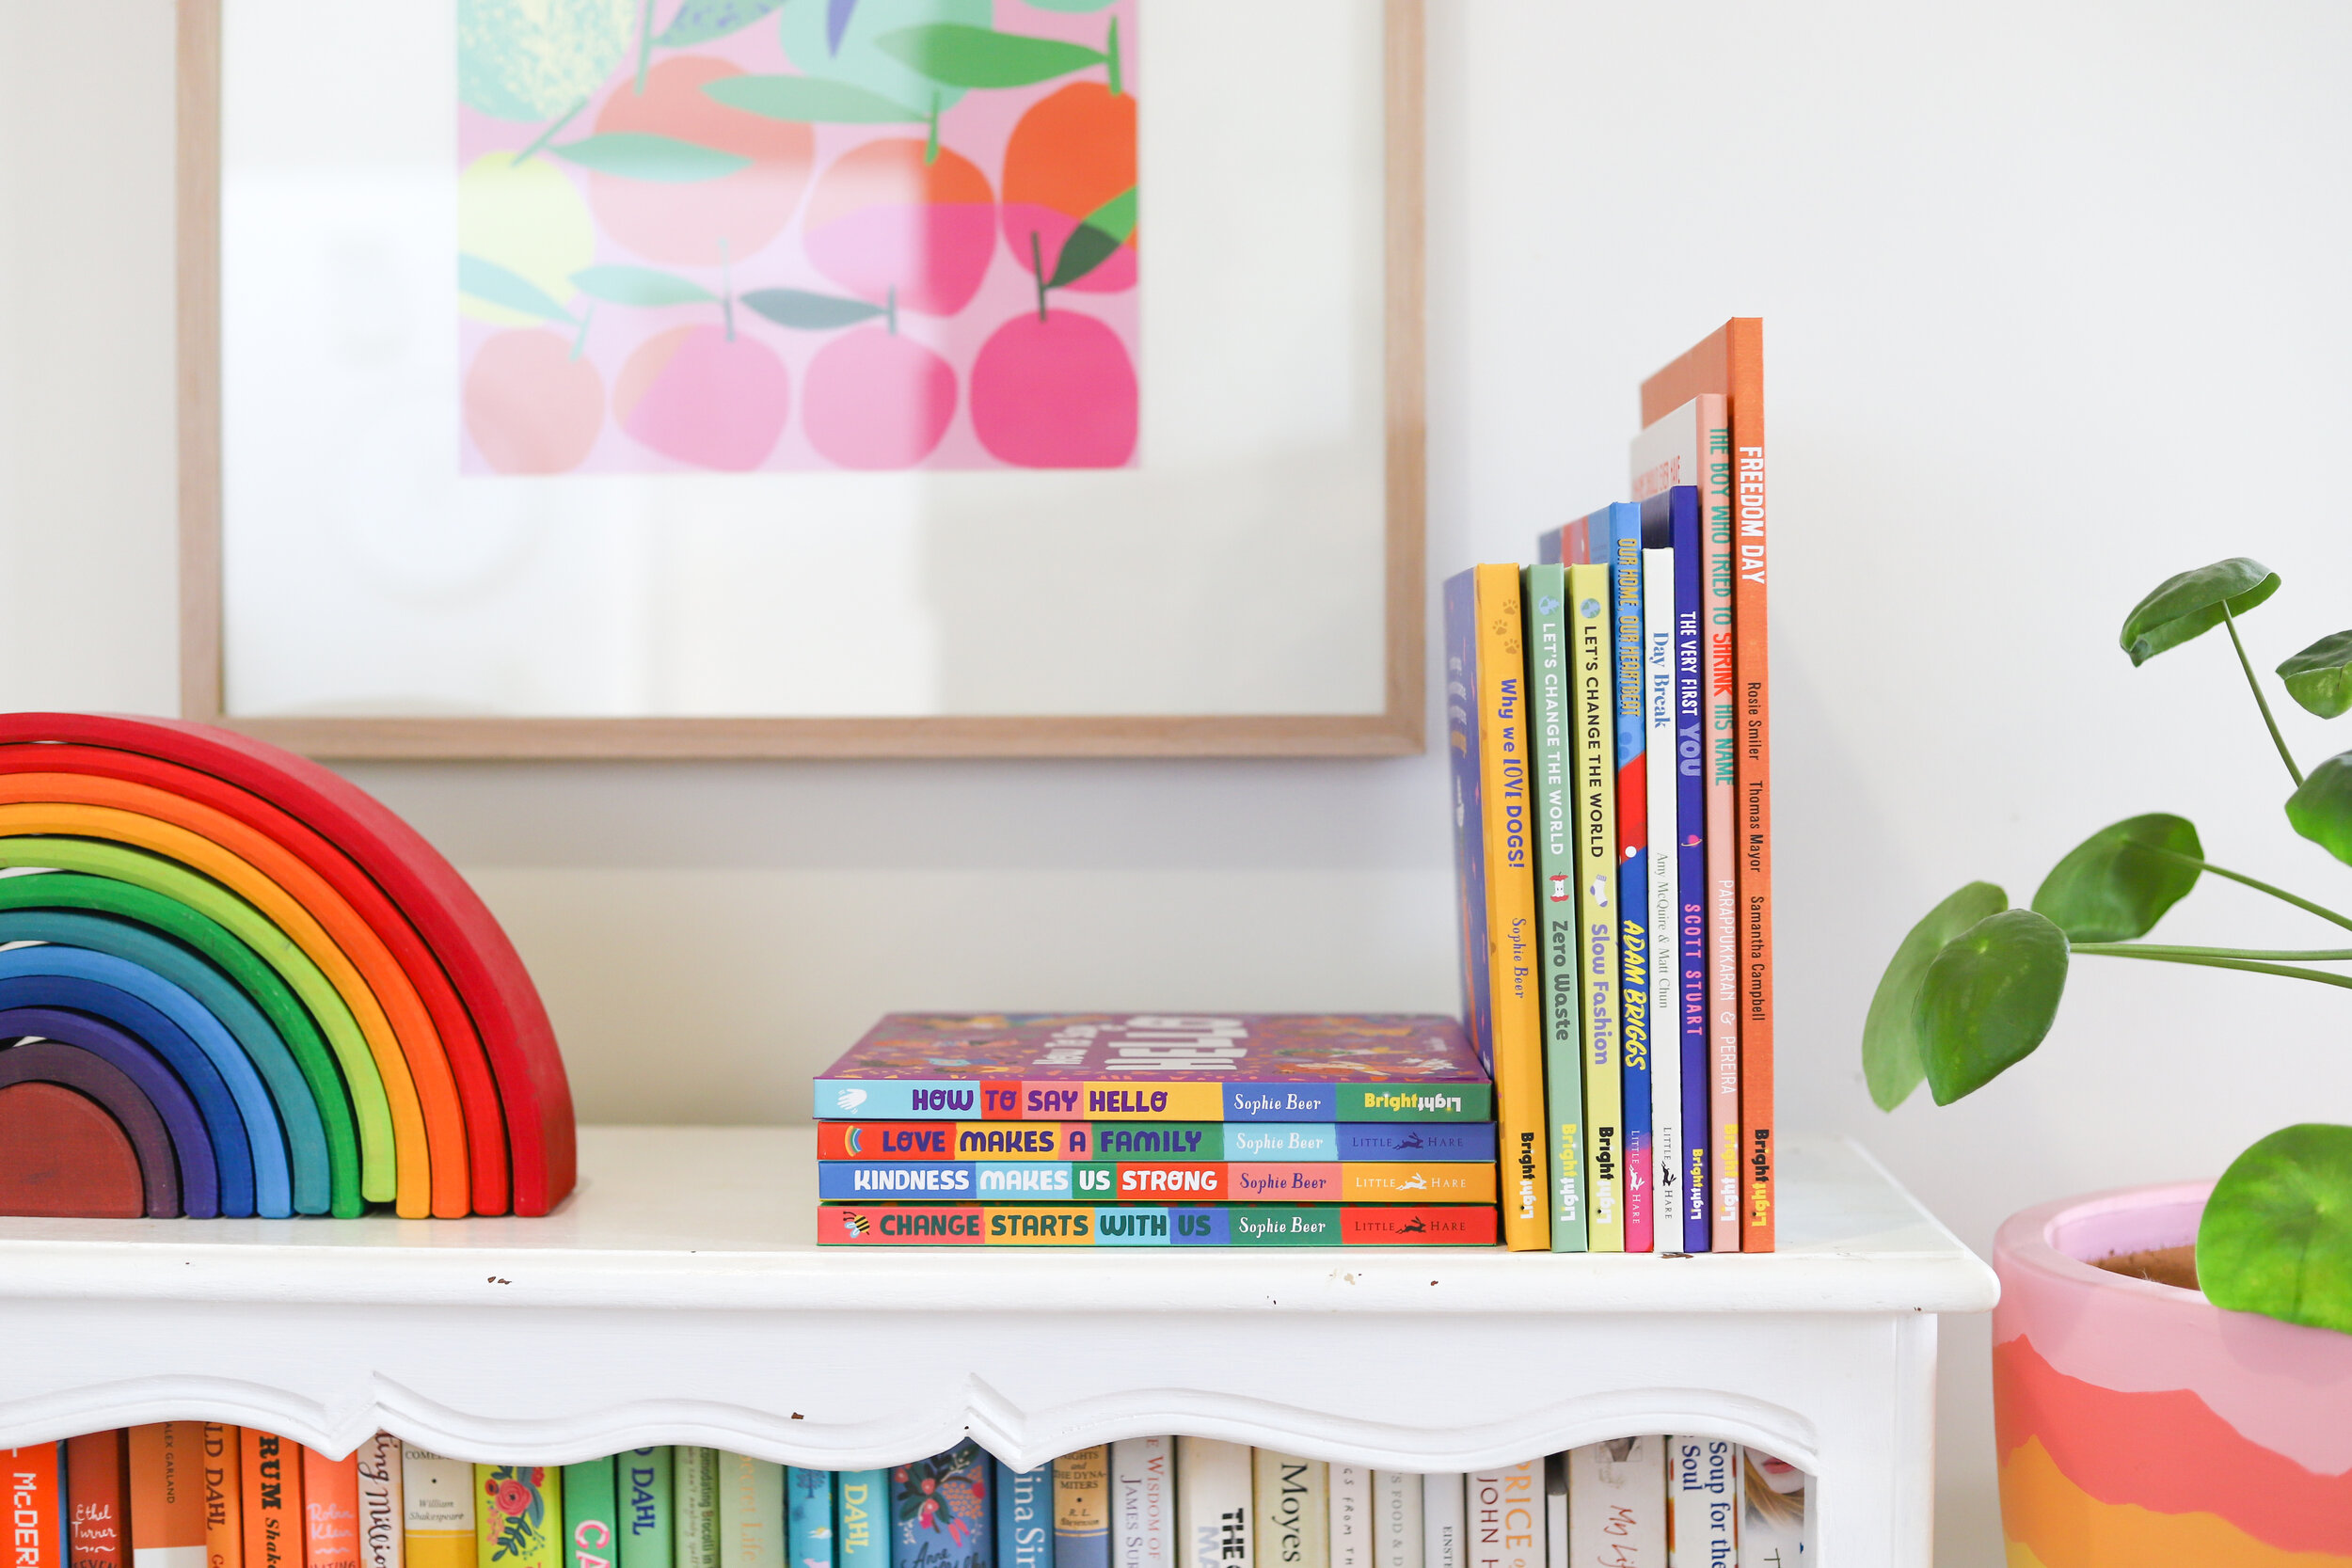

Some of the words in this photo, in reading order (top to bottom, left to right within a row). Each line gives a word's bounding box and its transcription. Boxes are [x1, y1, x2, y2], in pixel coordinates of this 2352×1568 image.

[1709, 428, 1728, 455] THE
[1710, 464, 1729, 496] BOY
[1740, 446, 1764, 537] FREEDOM
[1710, 506, 1730, 545] WHO
[1617, 538, 1638, 566] OUR
[1740, 546, 1766, 584] DAY
[1618, 570, 1639, 611] HOME,
[1711, 554, 1731, 597] TRIED
[1619, 616, 1640, 643] OUR
[1680, 611, 1696, 635] THE
[1712, 606, 1732, 626] TO
[1543, 623, 1557, 668] LET'S
[1584, 626, 1597, 671] LET'S
[1649, 632, 1669, 668] Day
[1680, 641, 1696, 675] VERY
[1619, 646, 1641, 717] HEARTBEAT
[1712, 632, 1732, 698] SHRINK
[1498, 678, 1518, 719] Why
[1545, 674, 1559, 747] CHANGE
[1586, 677, 1599, 749] CHANGE
[1654, 673, 1670, 729] Break
[1681, 678, 1697, 716] FIRST
[1747, 682, 1761, 716] Rosie
[1713, 705, 1733, 732] HIS
[1502, 727, 1515, 752] we
[1679, 721, 1701, 777] YOU
[1748, 720, 1762, 761] Smiler
[1547, 752, 1561, 785] THE
[1588, 754, 1601, 787] THE
[1714, 737, 1734, 786] NAME
[1549, 790, 1564, 855] WORLD
[1749, 780, 1763, 829] Thomas
[1506, 805, 1525, 868] DOGS!
[1589, 793, 1604, 857] WORLD
[1654, 853, 1668, 876] Amy
[1749, 834, 1763, 873] Mayor
[1656, 881, 1670, 930] McQuire
[1512, 918, 1527, 961] Sophie
[1552, 921, 1568, 966] Zero
[1658, 934, 1669, 943] &
[1684, 904, 1702, 958] SCOTT
[1718, 879, 1737, 1001] PARAPPUKKARAN
[1750, 896, 1765, 958] Samantha
[1591, 924, 1611, 974] Slow
[1623, 920, 1645, 985] ADAM
[1658, 948, 1670, 974] Matt
[1515, 966, 1529, 998] Beer
[1658, 979, 1668, 1008] Chun
[1749, 964, 1766, 1021] Campbell
[1554, 974, 1570, 1040] Waste
[1685, 970, 1704, 1036] STUART
[1720, 1011, 1737, 1026] &
[1593, 981, 1613, 1065] Fashion
[1624, 989, 1647, 1070] BRIGGS
[1720, 1036, 1738, 1094] PEREIRA
[913, 1089, 974, 1111] HOW
[985, 1090, 1016, 1111] TO
[1027, 1090, 1078, 1112] SAY
[1089, 1091, 1168, 1112] HELLO
[1234, 1094, 1281, 1115] Sophie
[1286, 1094, 1321, 1110] Beer
[882, 1131, 946, 1152] LOVE
[960, 1132, 1055, 1152] MAKES
[1070, 1132, 1086, 1152] A
[1101, 1131, 1201, 1152] FAMILY
[1236, 1132, 1283, 1154] Sophie
[1288, 1133, 1323, 1149] Beer
[1353, 1136, 1392, 1148] LITTLE
[1428, 1136, 1463, 1148] HARE
[1631, 1130, 1640, 1164] LITTLE
[1663, 1127, 1672, 1161] LITTLE
[854, 1170, 969, 1191] KINDNESS
[979, 1171, 1068, 1191] MAKES
[1079, 1171, 1110, 1191] US
[1122, 1170, 1217, 1191] STRONG
[1240, 1173, 1287, 1194] Sophie
[1292, 1173, 1327, 1189] Beer
[1356, 1177, 1395, 1188] LITTLE
[1432, 1177, 1467, 1188] HARE
[1632, 1194, 1641, 1224] HARE
[1664, 1190, 1673, 1219] HARE
[880, 1215, 979, 1236] CHANGE
[991, 1215, 1088, 1236] STARTS
[1100, 1215, 1167, 1236] WITH
[1178, 1215, 1211, 1236] US
[1239, 1216, 1286, 1238] Sophie
[1291, 1217, 1326, 1233] Beer
[1355, 1221, 1394, 1231] LITTLE
[1431, 1221, 1466, 1231] HARE
[165, 1422, 173, 1449] ALEX
[204, 1421, 224, 1458] LD
[166, 1452, 176, 1504] GARLAND
[260, 1436, 281, 1510] RUM
[1054, 1470, 1072, 1480] THE
[1060, 1481, 1099, 1490] MITERS
[1682, 1445, 1703, 1491] Soul
[1705, 1442, 1727, 1494] Soup
[75, 1503, 112, 1521] Ethel
[205, 1467, 226, 1531] DAHL
[308, 1503, 355, 1521] Robin
[408, 1513, 464, 1523] Shakespeare
[420, 1498, 454, 1508] William
[631, 1467, 655, 1536] DAHL
[1272, 1463, 1308, 1562] Moyes
[1391, 1491, 1403, 1533] FOOD
[1477, 1478, 1499, 1543] JOHN
[1710, 1502, 1730, 1531] for
[13, 1473, 40, 1568] McDER
[72, 1521, 117, 1539] Turner
[365, 1487, 391, 1568] Millio
[845, 1484, 869, 1554] DAHL
[1222, 1508, 1244, 1560] THE
[1604, 1505, 1637, 1535] My
[740, 1523, 765, 1561] Life
[1711, 1540, 1732, 1568] the
